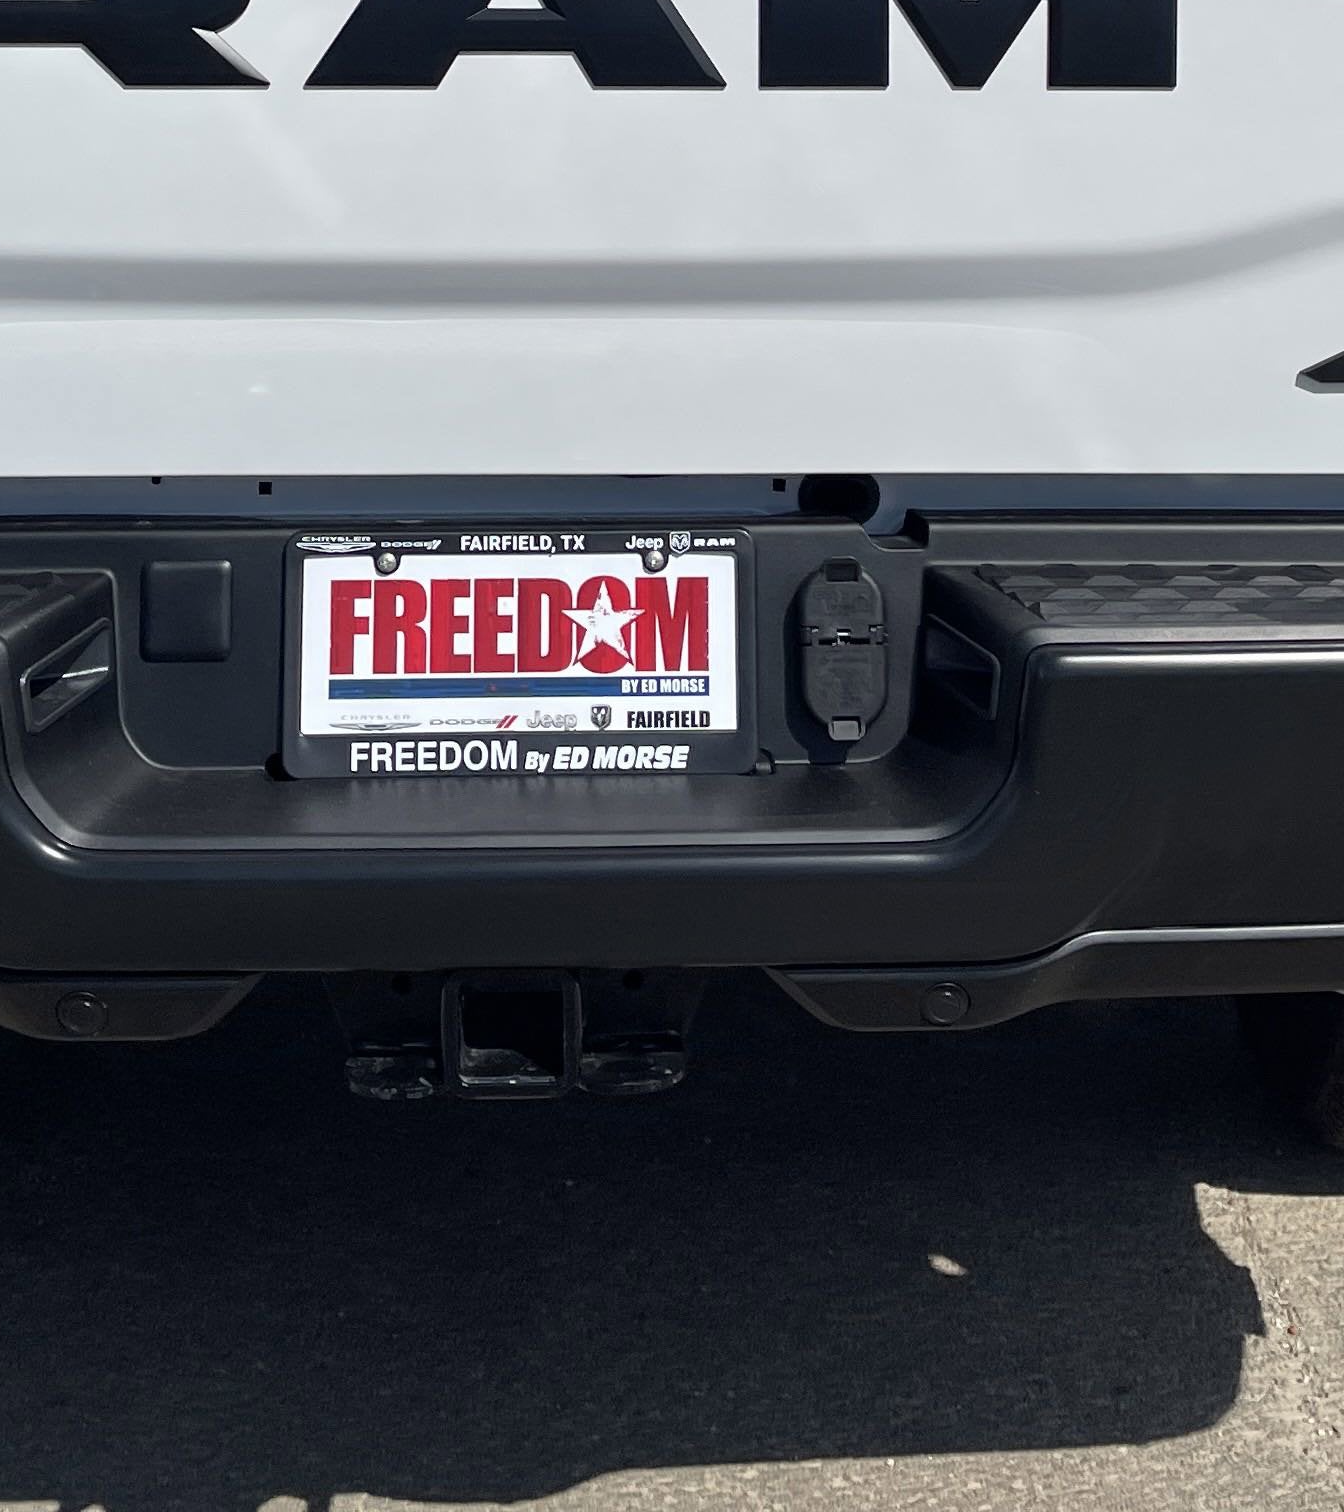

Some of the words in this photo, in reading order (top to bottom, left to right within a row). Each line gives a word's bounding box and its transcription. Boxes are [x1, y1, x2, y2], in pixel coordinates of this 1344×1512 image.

[380, 541, 432, 549] DODGE
[460, 534, 556, 553] FAIRFIELD,
[560, 534, 586, 551] TX
[625, 535, 664, 551] Jeep
[693, 537, 736, 547] RAM
[329, 575, 710, 675] FREEDOM
[621, 679, 639, 694] BY
[641, 679, 657, 694] ED
[659, 678, 706, 694] MORSE
[429, 718, 501, 727] DODGE
[526, 710, 578, 732] Jeep
[626, 710, 711, 729] FAIRFIELD
[350, 740, 518, 772] FREEDOM
[524, 750, 551, 773] By
[552, 747, 590, 770] ED
[591, 745, 691, 770] MORSE
